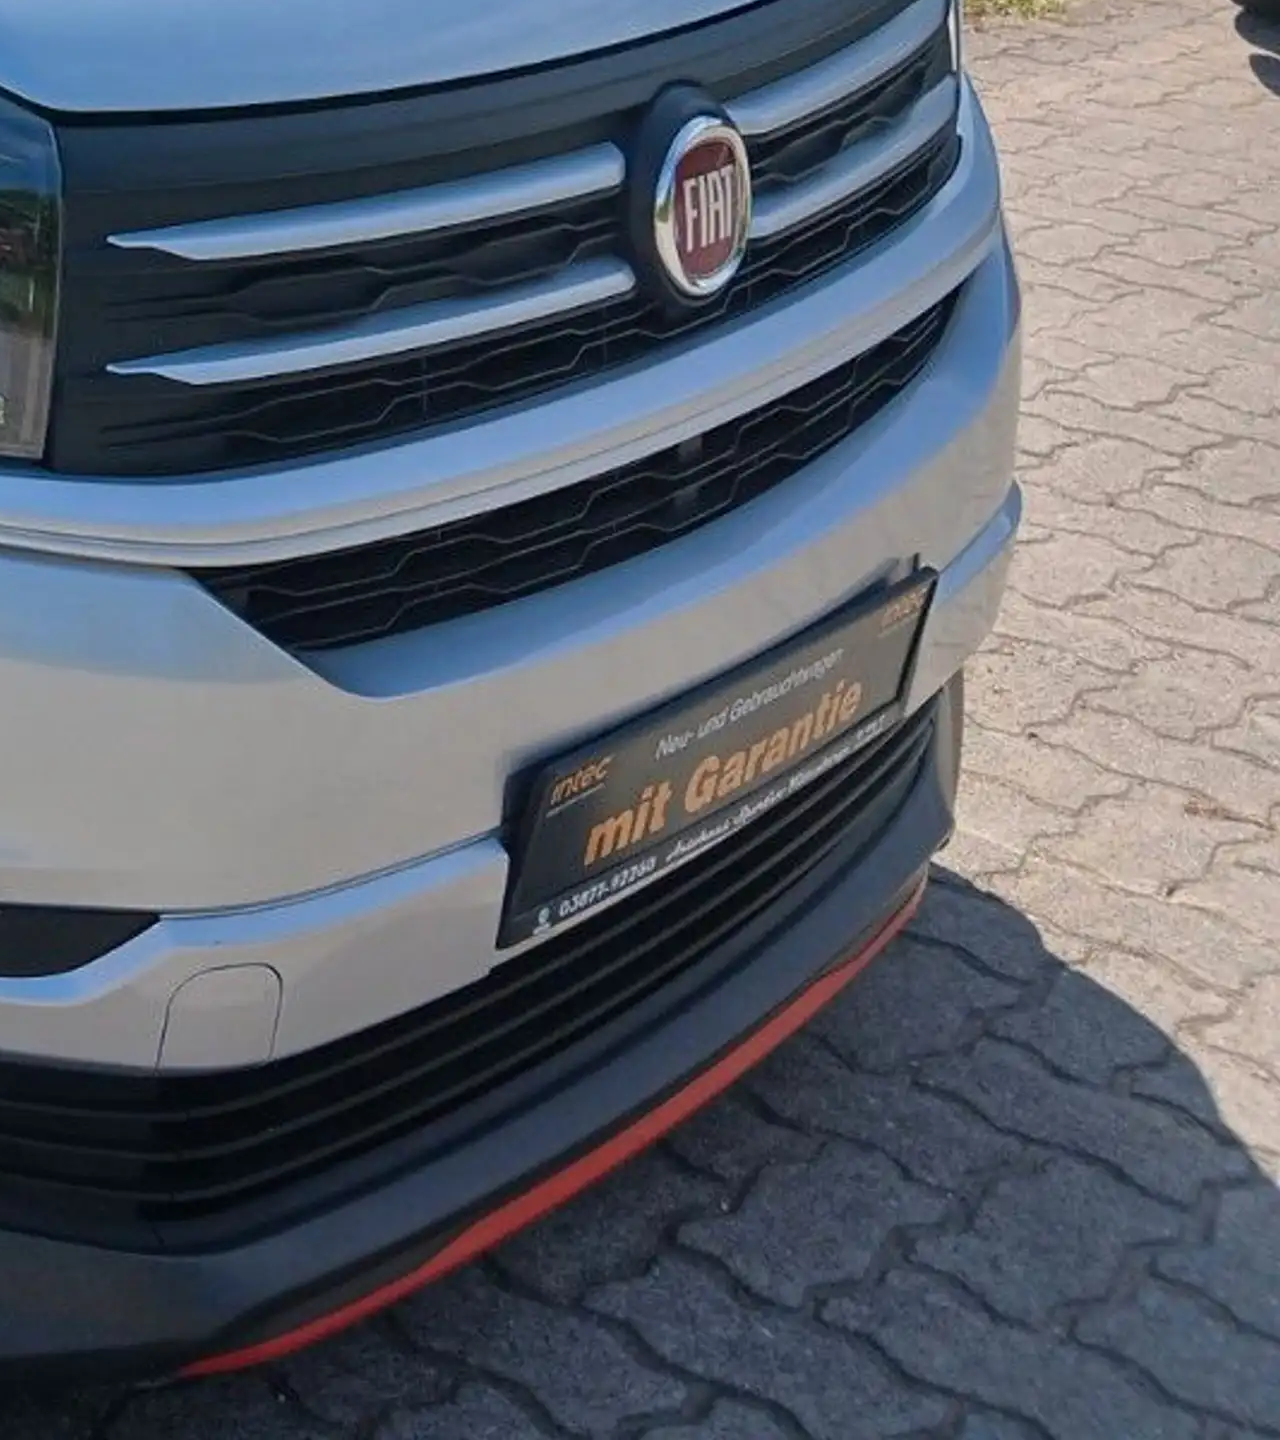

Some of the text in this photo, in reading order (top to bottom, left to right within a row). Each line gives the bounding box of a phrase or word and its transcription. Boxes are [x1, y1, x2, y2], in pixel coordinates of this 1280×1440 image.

[682, 163, 735, 253] FIAT
[584, 780, 673, 867] mit
[684, 681, 864, 813] Garantie
